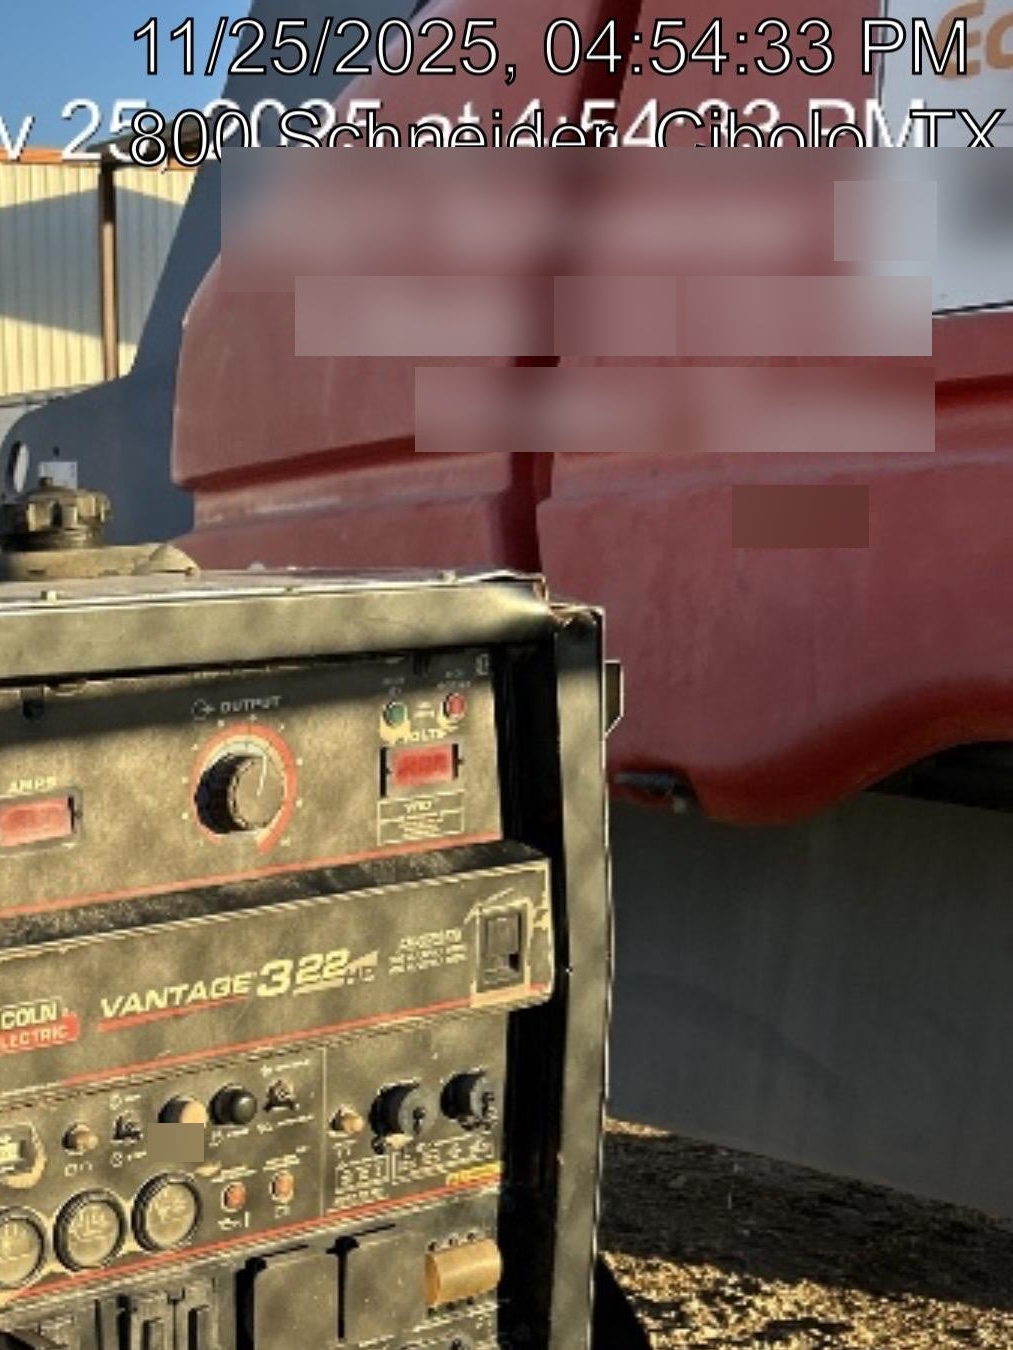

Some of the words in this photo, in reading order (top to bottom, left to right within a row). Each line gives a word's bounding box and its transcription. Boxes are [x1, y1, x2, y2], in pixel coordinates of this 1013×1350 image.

[220, 696, 281, 714] OUTPUT
[100, 970, 253, 1019] VANTAGE
[256, 948, 351, 998] 322
